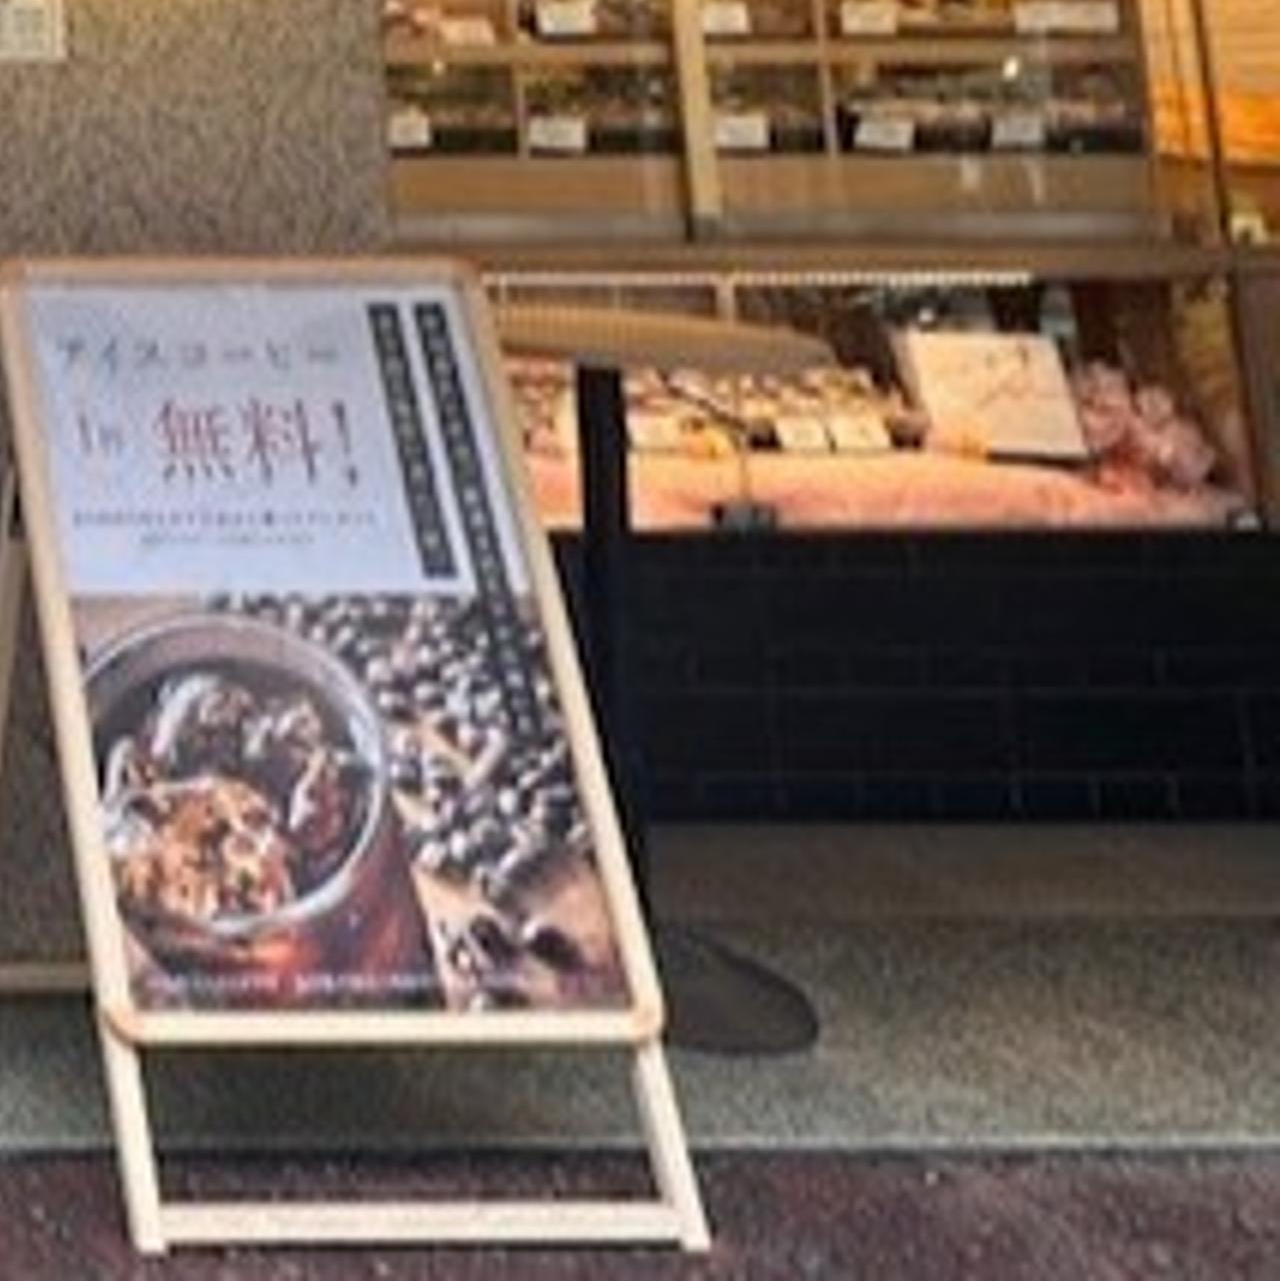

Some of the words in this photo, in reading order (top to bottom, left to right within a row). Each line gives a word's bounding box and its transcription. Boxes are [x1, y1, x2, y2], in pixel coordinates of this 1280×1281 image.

[54, 336, 338, 376] アイスコーヒー
